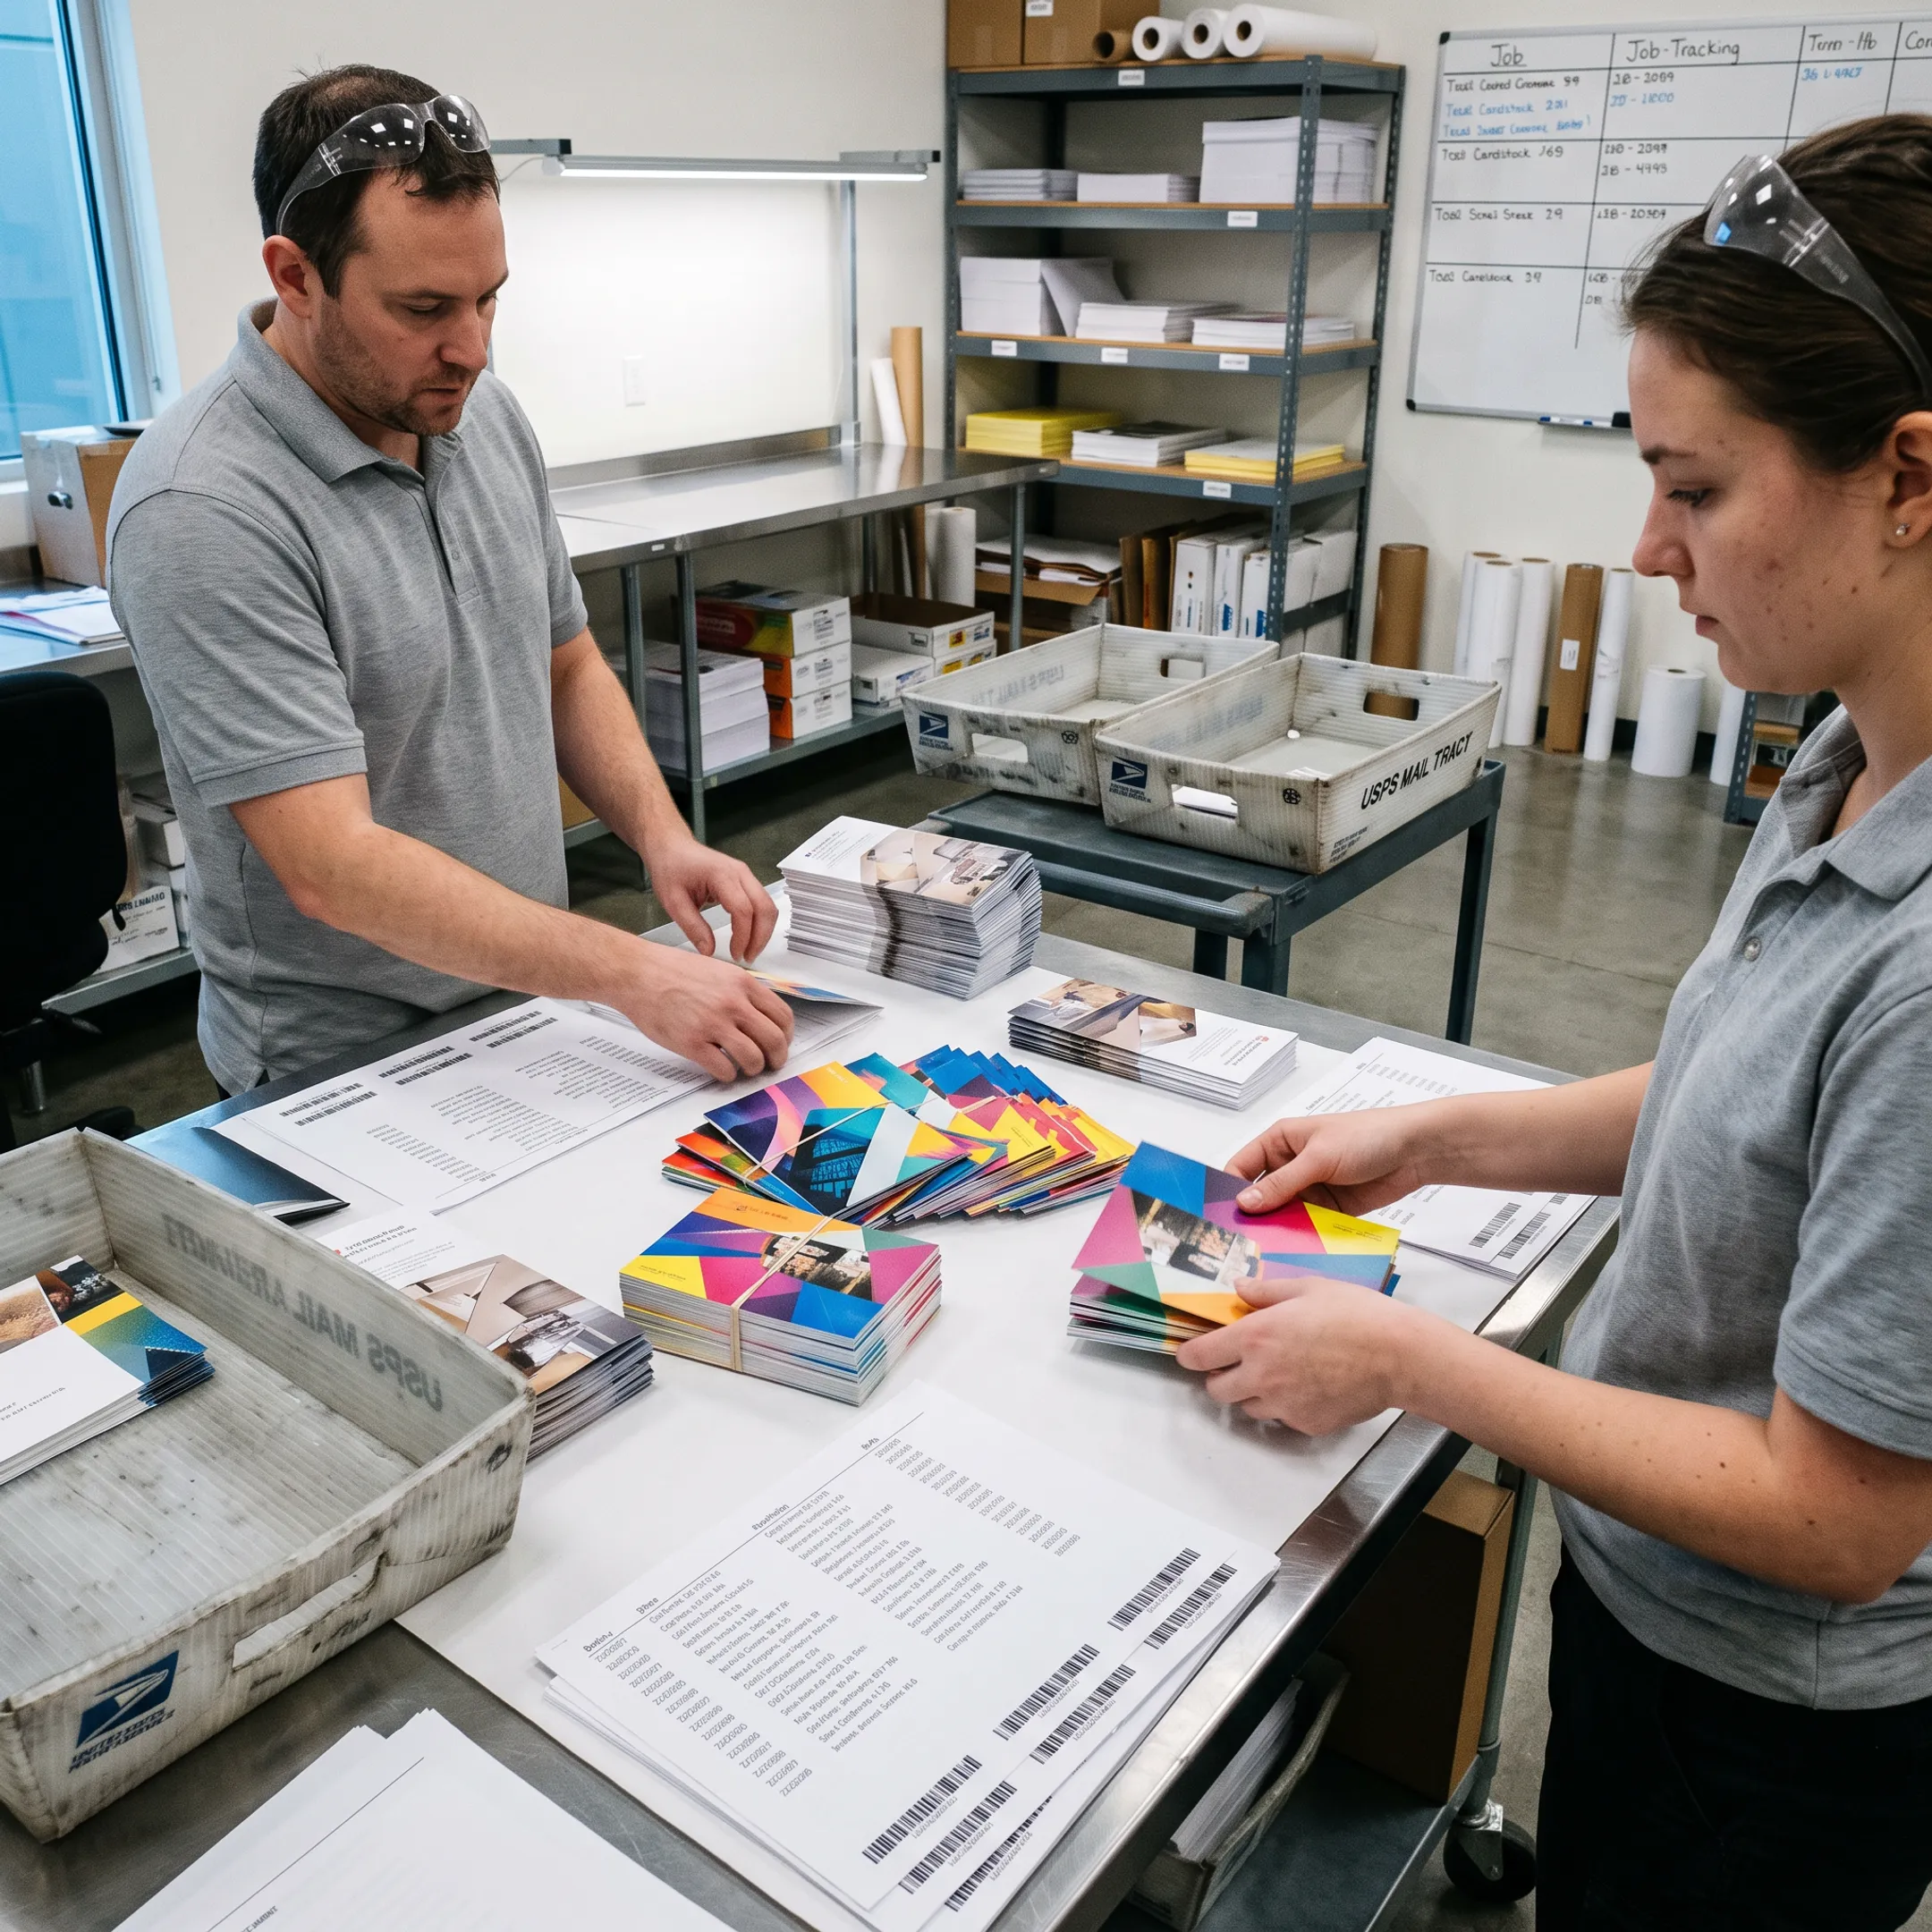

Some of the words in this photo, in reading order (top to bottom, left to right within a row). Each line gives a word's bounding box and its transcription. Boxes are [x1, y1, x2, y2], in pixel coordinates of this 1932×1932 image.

[1491, 44, 1525, 67] Job
[1626, 38, 1741, 65] Job-Tracking
[1473, 147, 1531, 160] Cardstock
[1546, 208, 1563, 220] 29
[1360, 772, 1400, 809] USPS
[1400, 758, 1428, 790] MAIL
